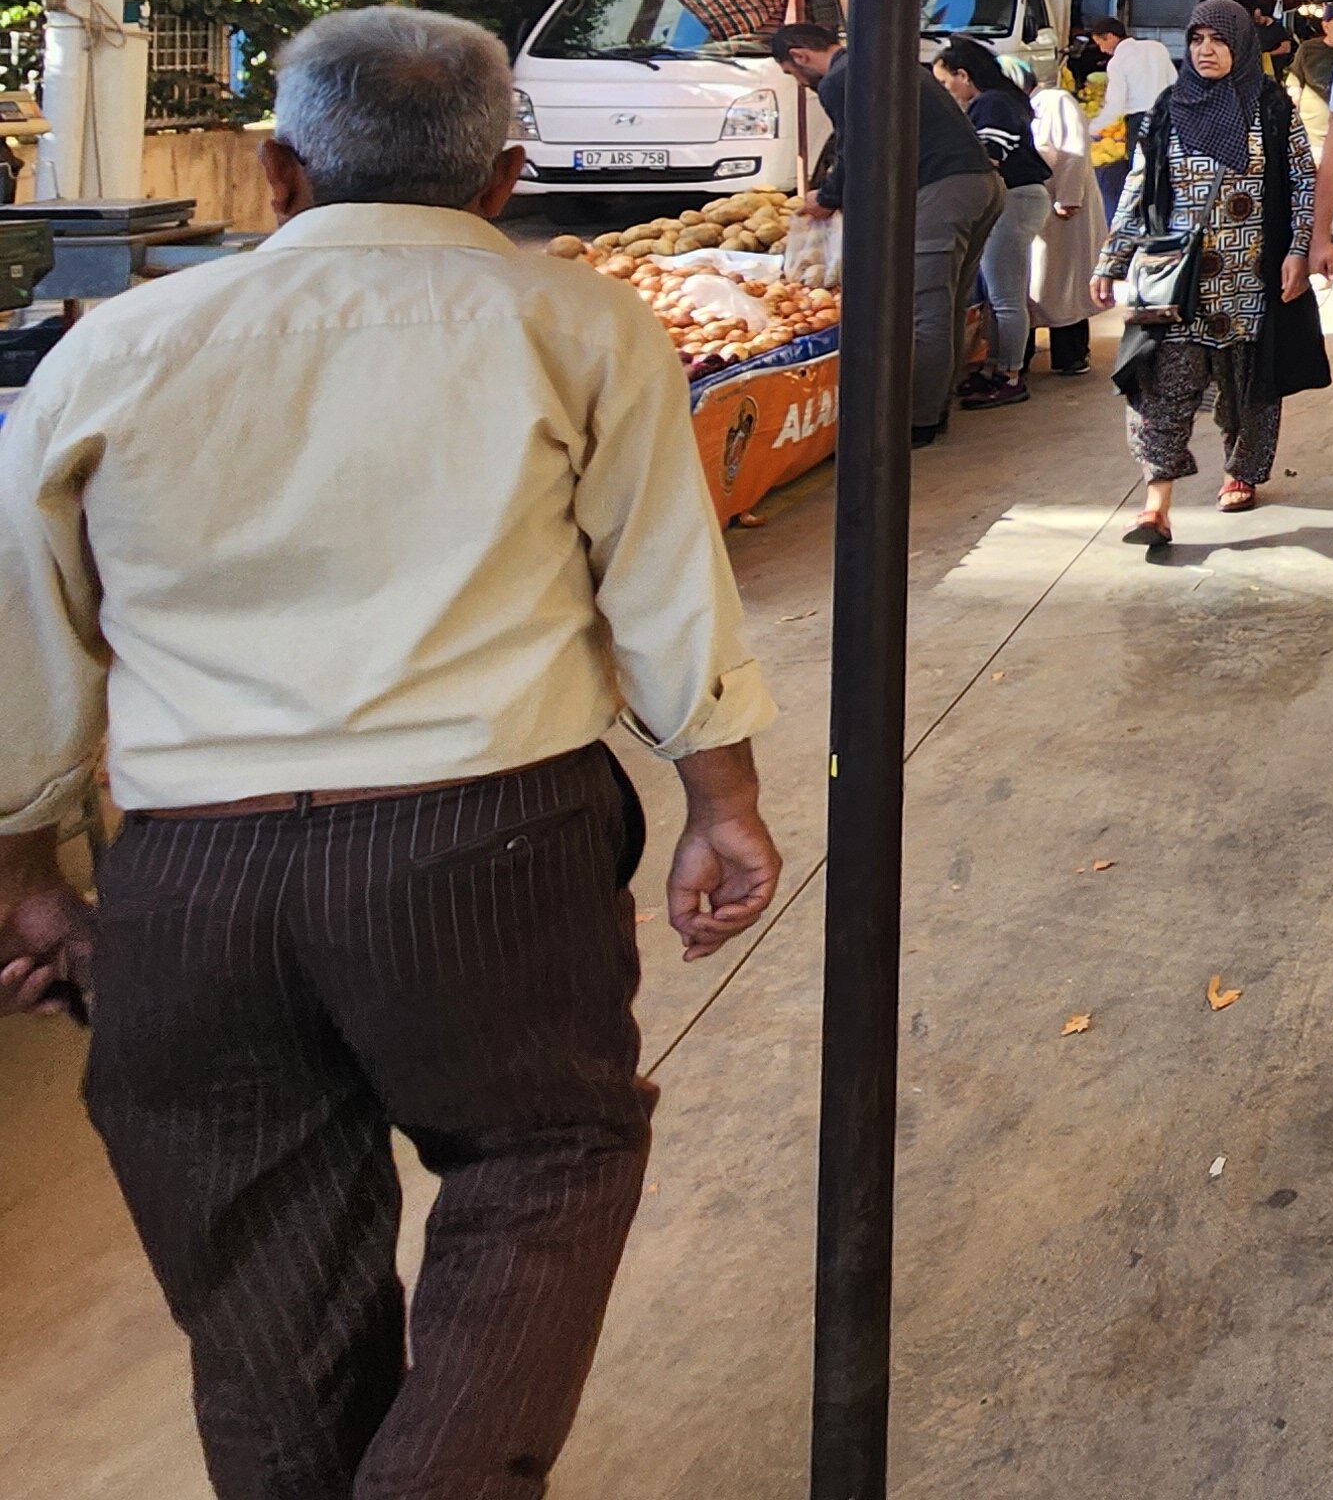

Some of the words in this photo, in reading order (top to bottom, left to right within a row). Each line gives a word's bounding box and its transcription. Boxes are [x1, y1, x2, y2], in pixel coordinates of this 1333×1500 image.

[586, 152, 601, 165] 07
[610, 152, 633, 165] ARS
[640, 152, 665, 165] 758
[770, 385, 839, 449] ALA
